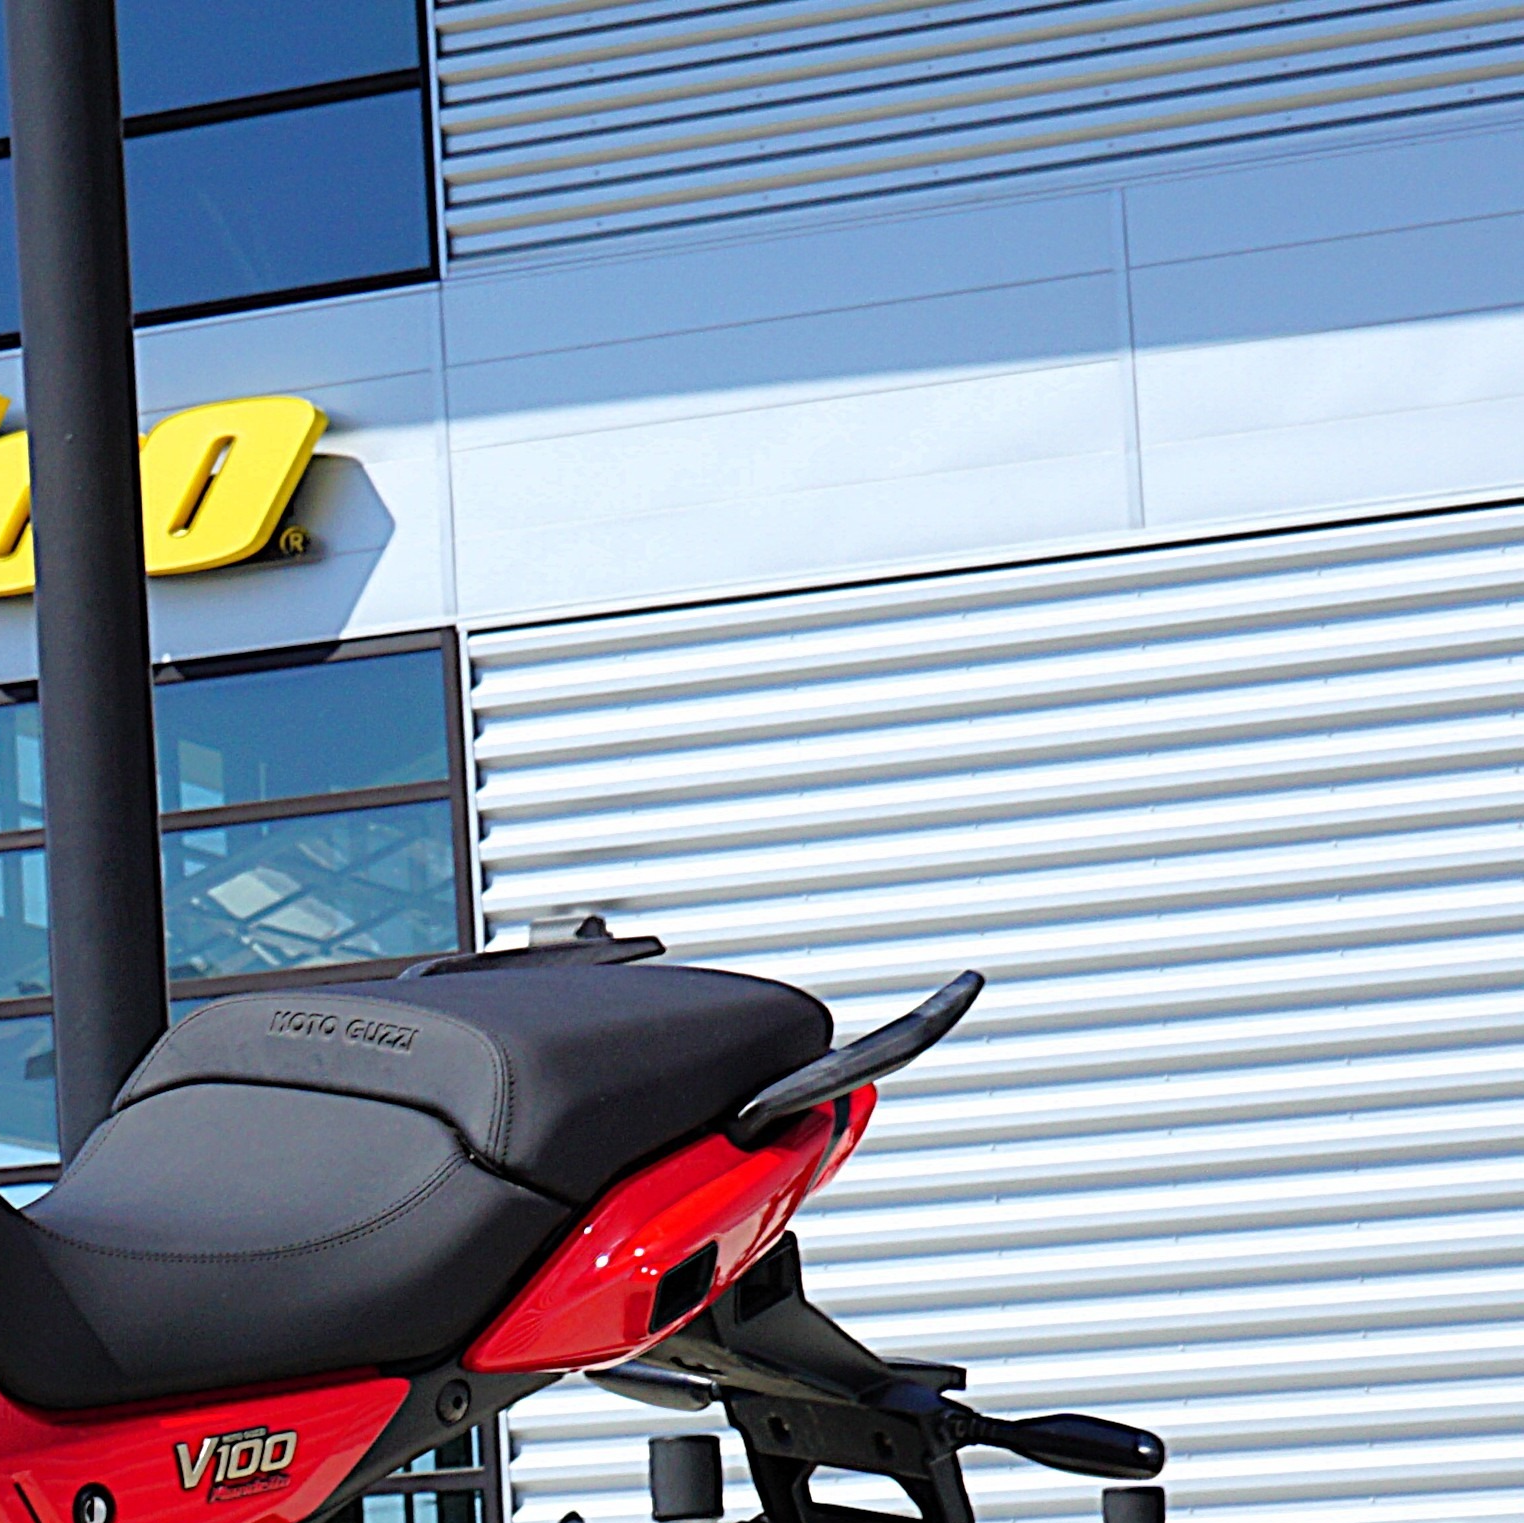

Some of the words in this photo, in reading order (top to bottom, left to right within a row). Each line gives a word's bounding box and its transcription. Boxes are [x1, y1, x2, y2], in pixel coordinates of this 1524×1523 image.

[268, 1010, 339, 1037] MOTO
[345, 1018, 420, 1053] GUZZI
[176, 1431, 297, 1489] V100
